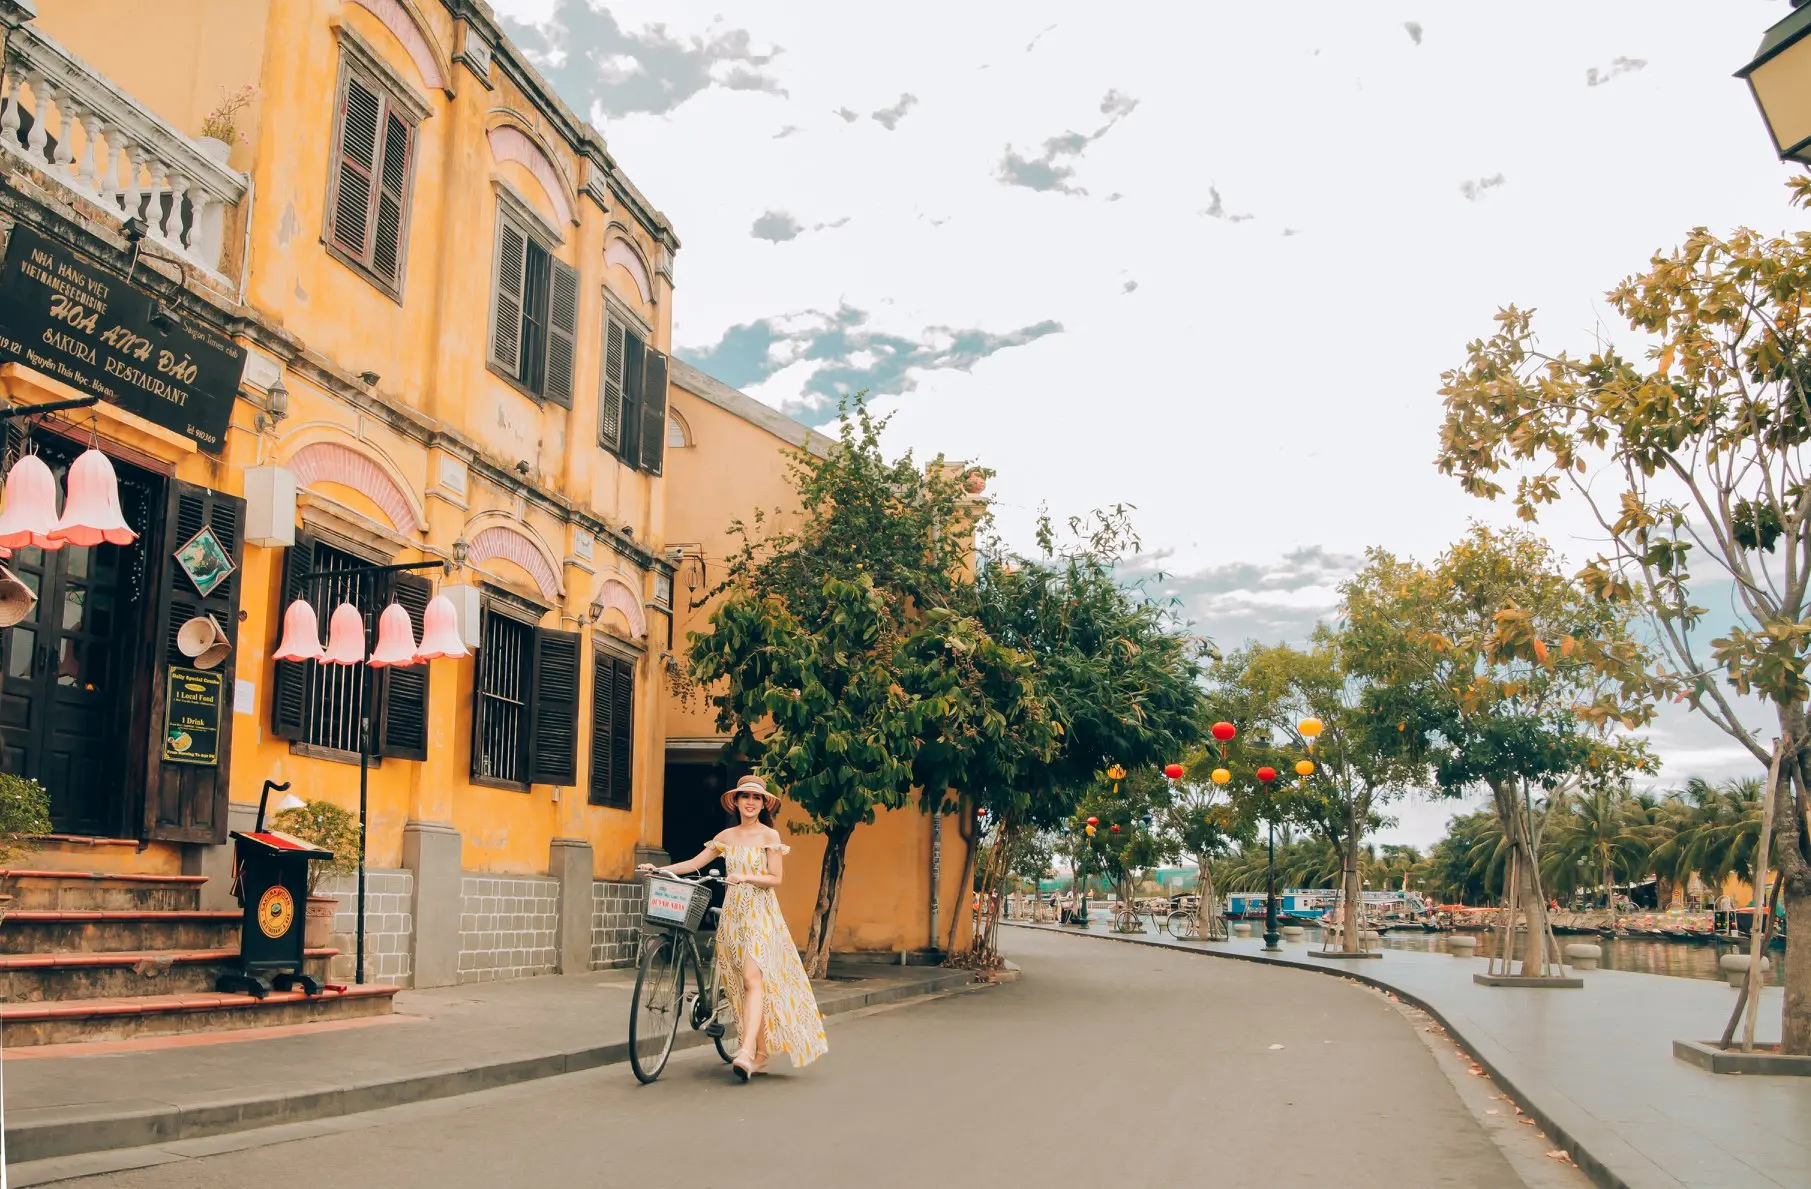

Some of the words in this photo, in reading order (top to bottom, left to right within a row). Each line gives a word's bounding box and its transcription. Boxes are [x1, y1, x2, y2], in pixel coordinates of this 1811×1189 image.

[50, 294, 99, 335] HOA
[100, 325, 154, 362] ANH
[157, 349, 198, 385] ĐÀO
[42, 328, 96, 366] SAKURA
[103, 357, 189, 407] RESTAURANT
[181, 691, 198, 700] Local
[199, 694, 214, 703] Food
[186, 717, 205, 726] Drink
